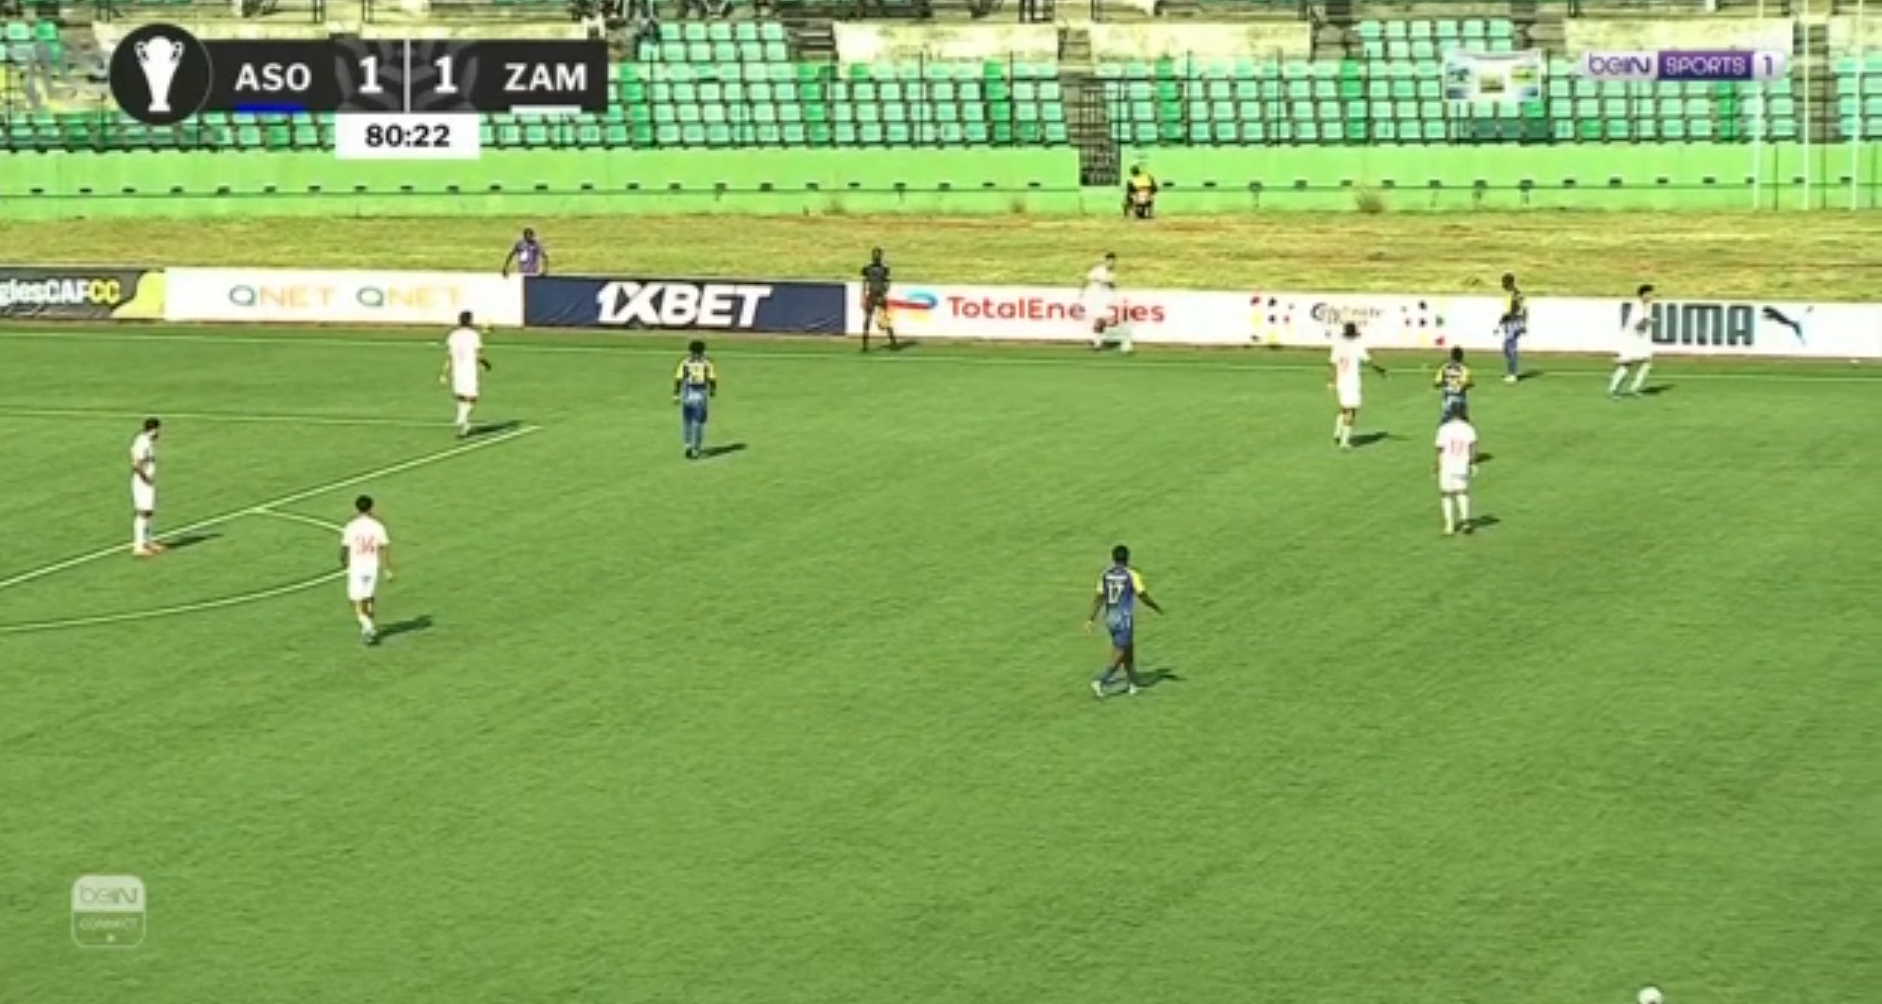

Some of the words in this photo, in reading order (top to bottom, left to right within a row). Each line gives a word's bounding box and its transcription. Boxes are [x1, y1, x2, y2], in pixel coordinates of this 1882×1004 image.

[228, 284, 334, 308] QNET
[356, 285, 463, 309] QNET
[595, 281, 773, 328] 1XBET
[947, 296, 1166, 328] TotalEnegies
[1107, 584, 1126, 604] 17
